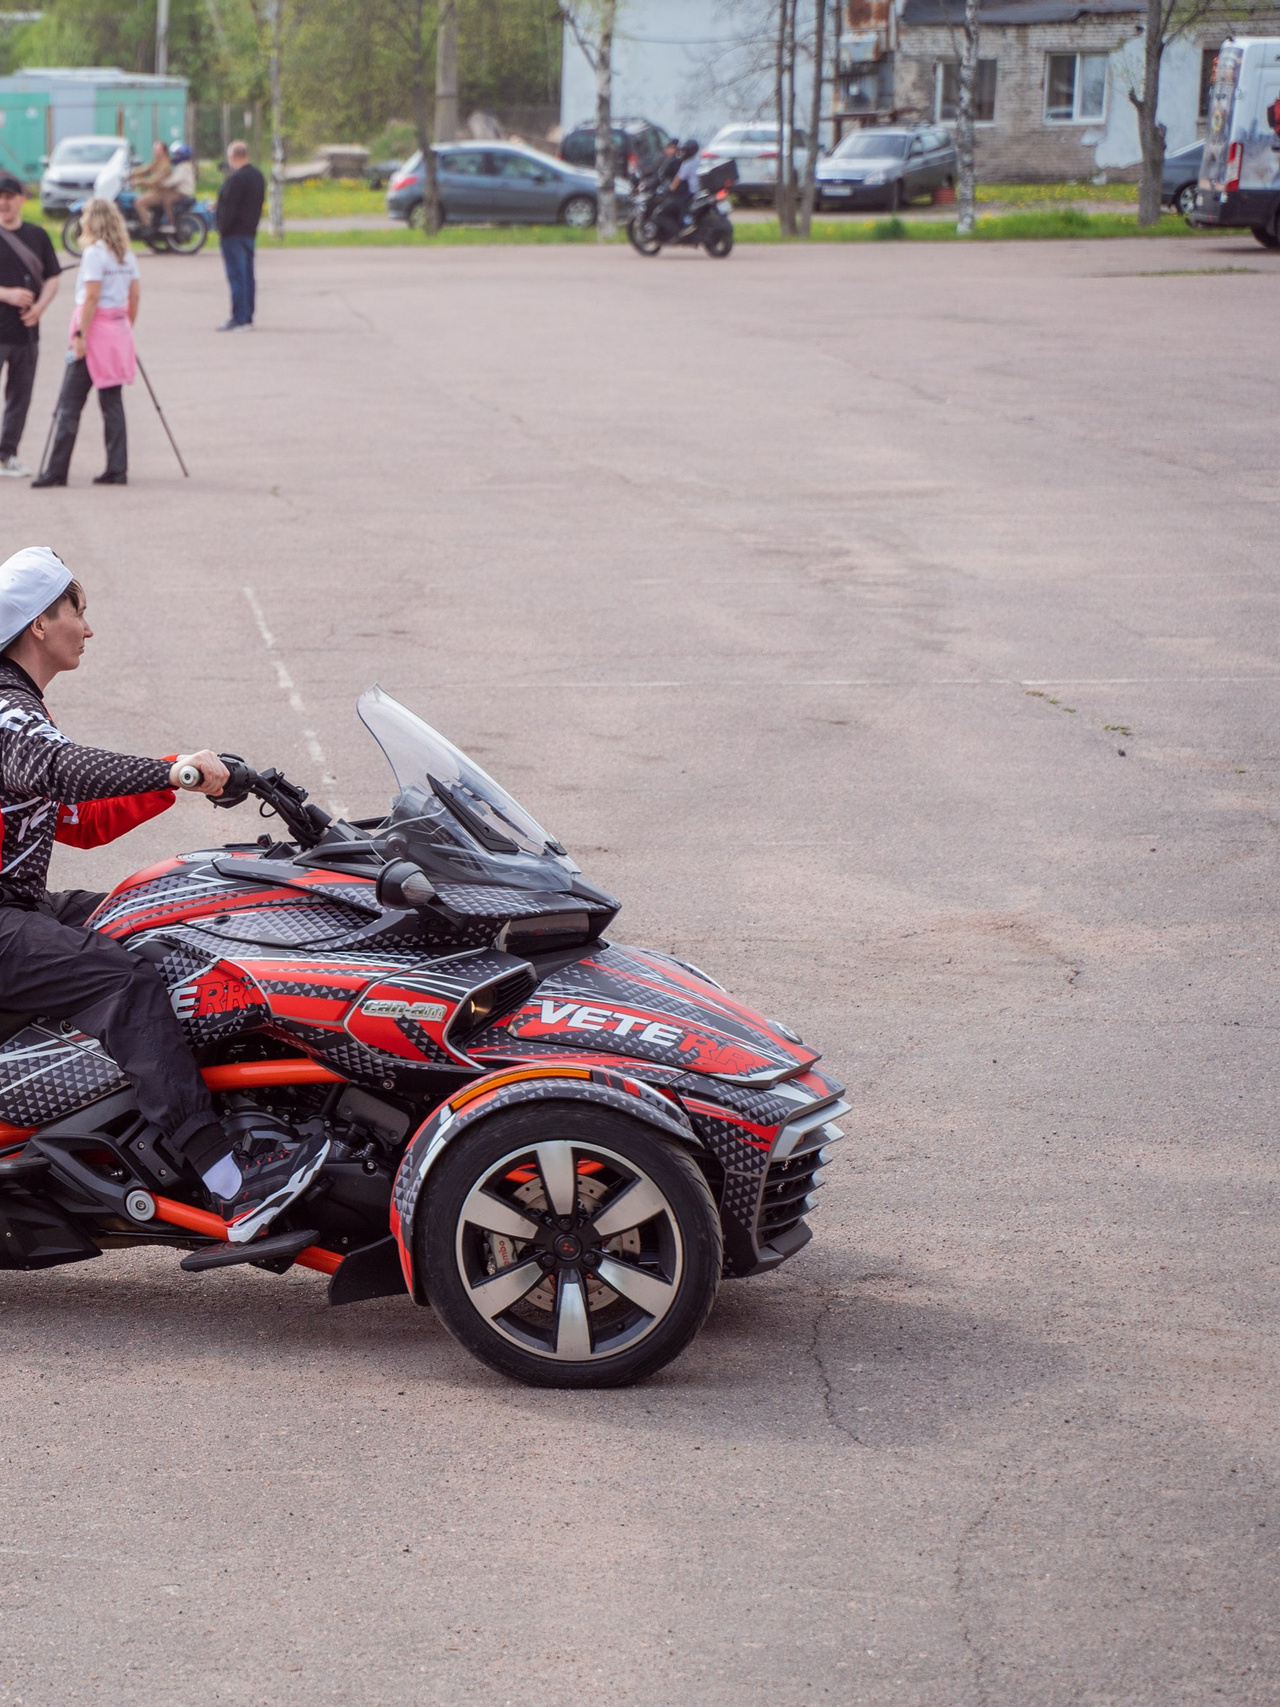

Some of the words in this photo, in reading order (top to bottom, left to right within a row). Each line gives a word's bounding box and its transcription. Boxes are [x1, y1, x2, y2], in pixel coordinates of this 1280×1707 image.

[170, 981, 247, 1019] ERR
[540, 1000, 754, 1076] VETERR
[498, 1240, 510, 1267] embo
